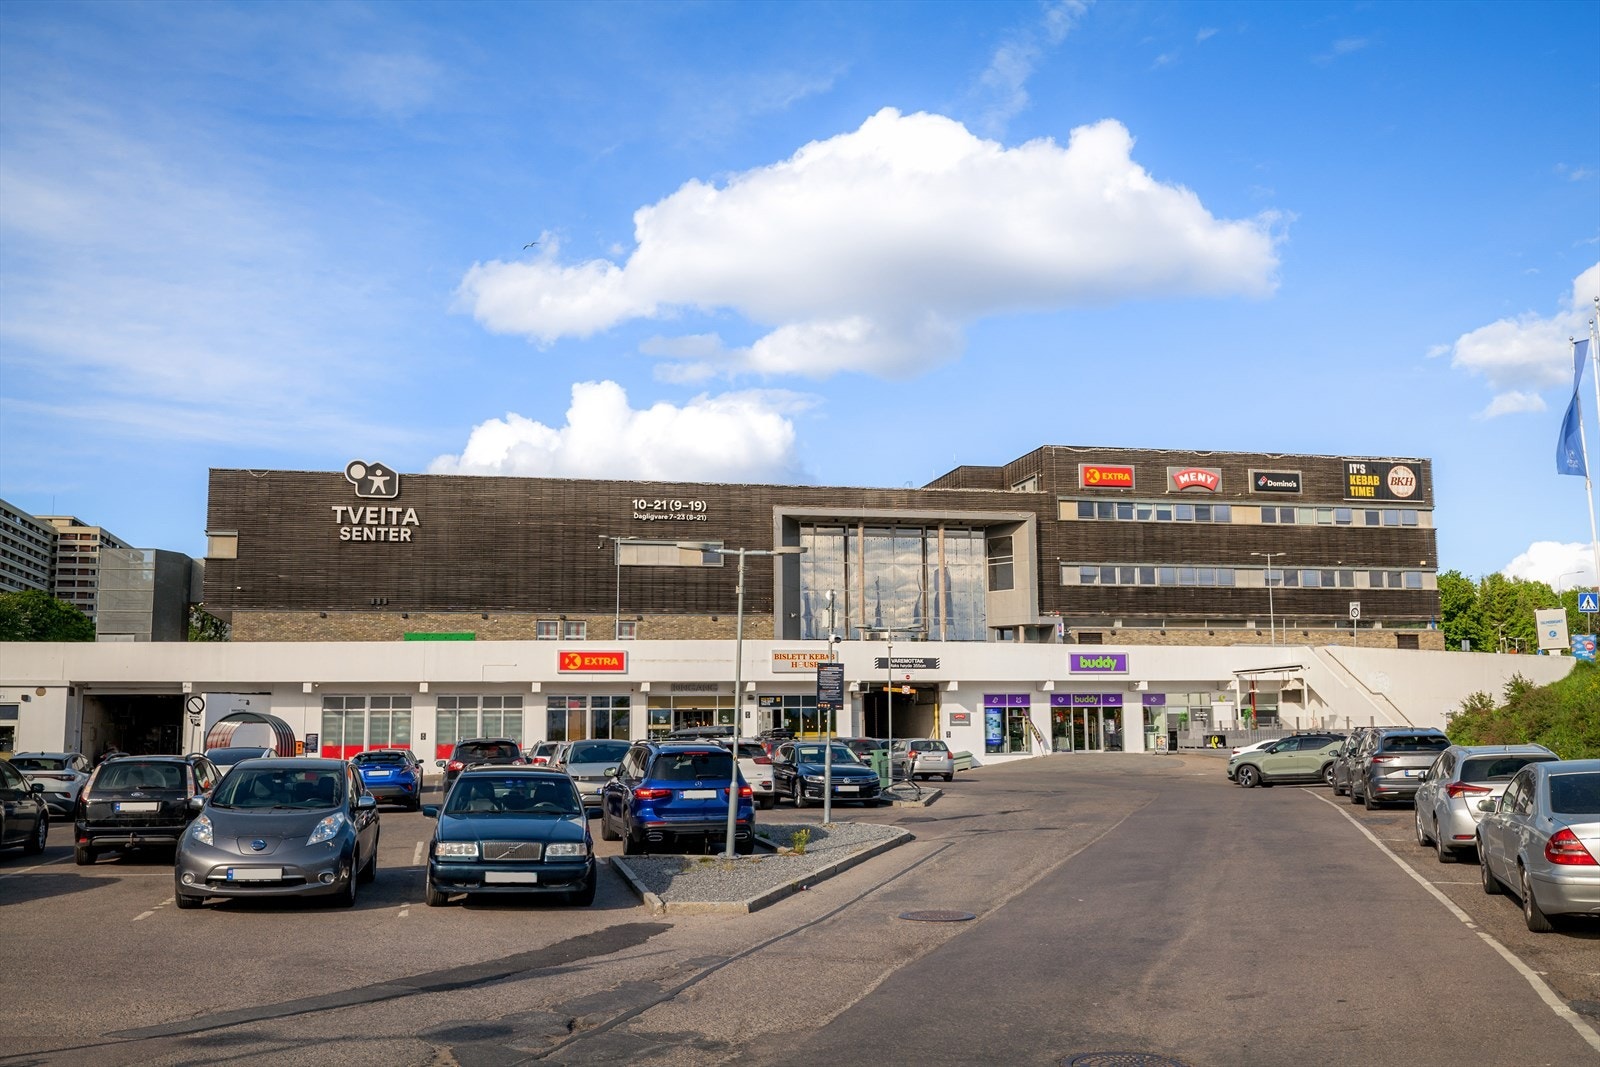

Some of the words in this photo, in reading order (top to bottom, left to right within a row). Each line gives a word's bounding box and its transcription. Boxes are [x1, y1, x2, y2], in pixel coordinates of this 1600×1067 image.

[1349, 463, 1366, 474] IT'S
[1102, 472, 1131, 481] EXTRA
[1179, 472, 1214, 485] MENY
[1349, 474, 1380, 486] KEBAB
[1390, 476, 1414, 486] BKH
[1267, 479, 1297, 488] Domino's
[1350, 486, 1375, 497] TIME!
[632, 499, 667, 510] 10-21
[669, 499, 707, 512] (9-19)
[331, 505, 420, 526] TVEITA
[633, 512, 669, 521] Dagligvare
[339, 526, 412, 542] SENTER
[584, 657, 619, 666] EXTRA
[1079, 655, 1117, 671] buddy
[1074, 695, 1098, 705] buddy
